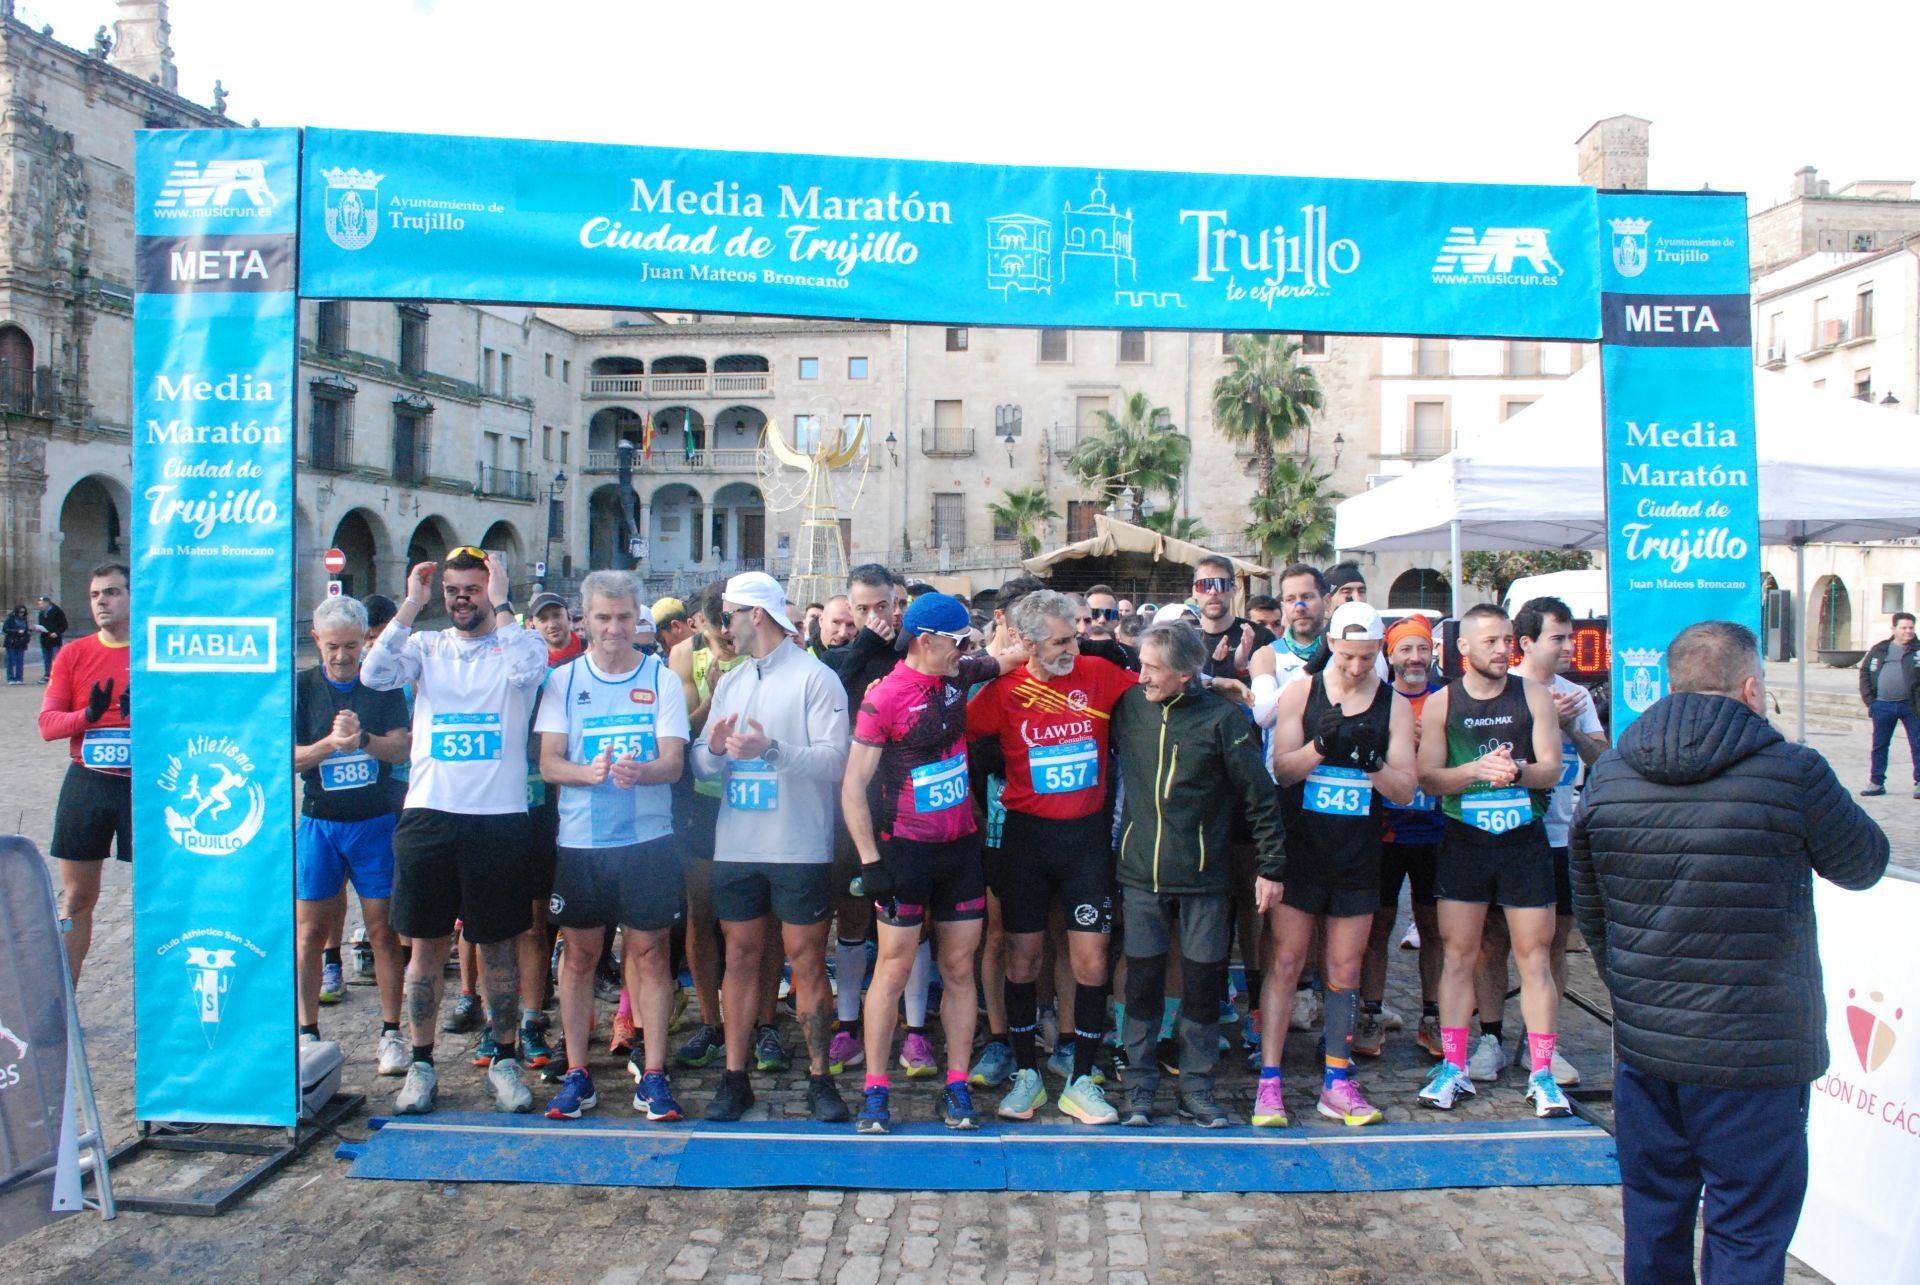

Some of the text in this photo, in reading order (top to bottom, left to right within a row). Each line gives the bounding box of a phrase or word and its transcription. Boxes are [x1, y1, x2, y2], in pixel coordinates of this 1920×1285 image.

[154, 205, 271, 219] www.musicrun.es
[389, 194, 505, 213] Ayuntamiento de
[630, 177, 952, 225] Media Maratón
[388, 210, 465, 232] Trujillo
[579, 216, 918, 277] Ciudad de Trujillo
[1180, 203, 1361, 289] Trujillo
[1655, 237, 1735, 249] Ayuntamiento de
[170, 249, 269, 282] META
[1655, 249, 1709, 266] Trujillo
[640, 262, 849, 289] Juan Mateos Broncano
[1431, 273, 1558, 286] www.musicrun.es
[1226, 275, 1246, 302] te
[1625, 304, 1720, 334] META
[155, 373, 274, 402] Media
[146, 419, 282, 444] Maratón
[1625, 421, 1738, 448] Media
[163, 457, 264, 479] Ciudad de
[1620, 462, 1749, 487] Maratón
[145, 484, 277, 539] Trujillo
[1636, 498, 1731, 518] Ciudad de
[150, 545, 274, 557] Juan Mateos Broncano
[1622, 523, 1748, 574] Trujillo
[1629, 579, 1746, 591] Juan Mateos Broncano
[167, 633, 259, 657] HABLA
[1033, 719, 1093, 740] LAWDE
[92, 745, 129, 763] 589
[443, 733, 486, 758] 531
[157, 735, 256, 792] Club Atletismo
[333, 763, 371, 784] 588
[1045, 763, 1089, 790] 557
[929, 776, 964, 808] 530
[1317, 787, 1360, 812] 543
[1476, 809, 1521, 832] 560
[156, 938, 180, 956] Club
[225, 931, 243, 943] San
[1811, 1073, 1920, 1138] CIÓN DE CÁC
